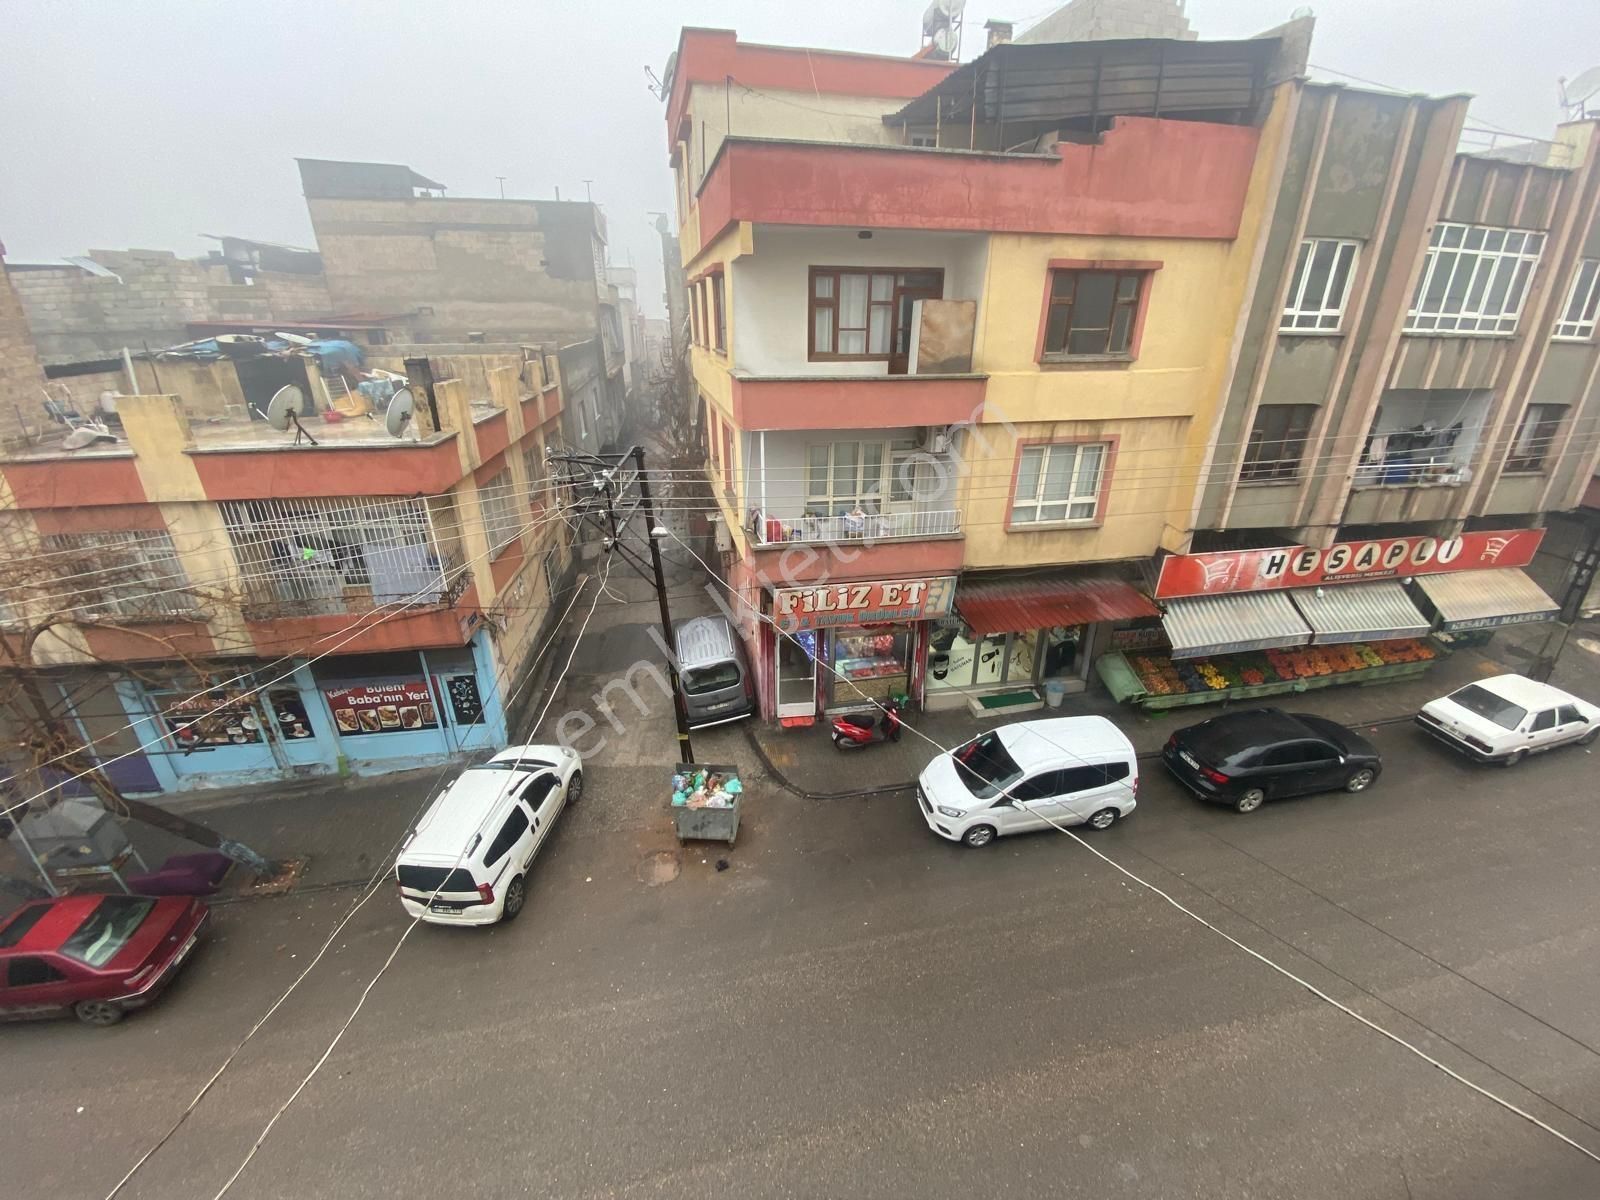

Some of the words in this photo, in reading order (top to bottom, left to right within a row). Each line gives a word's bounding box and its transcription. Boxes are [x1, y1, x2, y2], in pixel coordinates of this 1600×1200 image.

[1265, 541, 1456, 574] HESAPLI
[879, 582, 927, 606] ET
[347, 693, 404, 705] Baba'nın
[405, 689, 430, 701] Yeri
